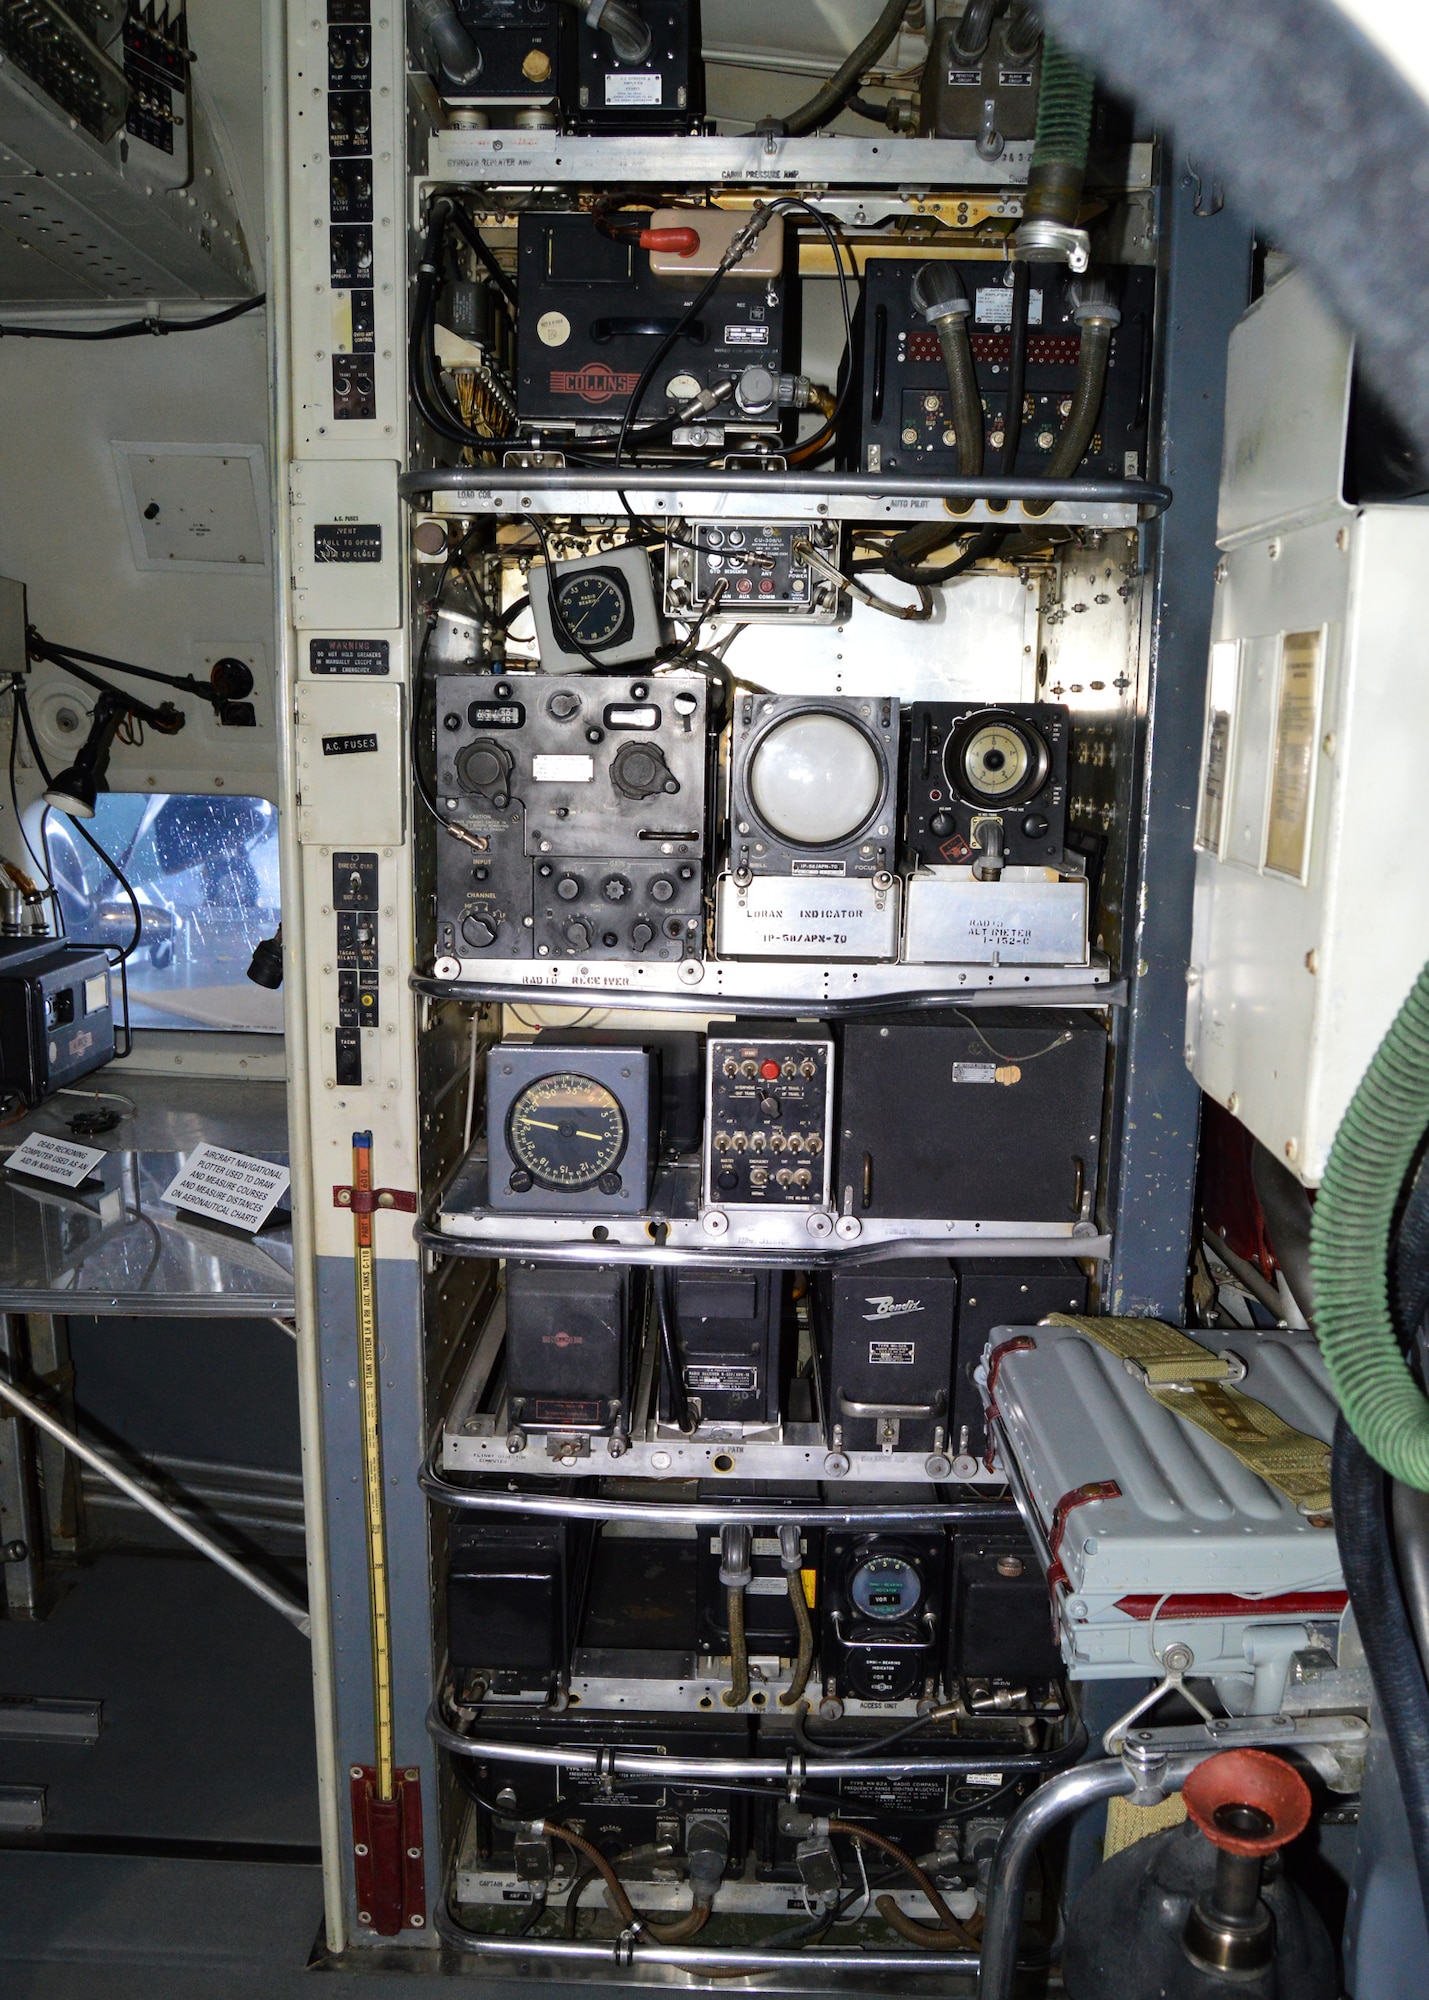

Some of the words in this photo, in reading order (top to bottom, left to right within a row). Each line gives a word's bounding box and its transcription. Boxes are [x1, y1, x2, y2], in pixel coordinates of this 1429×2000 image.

[481, 158, 515, 167] REPEATER
[746, 170, 781, 179] PRESSURE
[565, 375, 627, 391] COLLINS
[458, 490, 475, 499] LOAD
[890, 500, 909, 508] AUTO
[910, 500, 930, 509] PILOT
[338, 527, 357, 535] VENT
[328, 642, 370, 650] WARNING
[325, 741, 341, 751] A.C.
[344, 738, 376, 750] FUSES
[746, 910, 783, 918] LORAN
[800, 910, 863, 918] INDICATOR
[968, 919, 1004, 928] RADIO
[967, 928, 1032, 937] ALTIMETER
[522, 976, 558, 985] RADIO
[571, 976, 630, 986] RECEIVER
[544, 1090, 557, 1099] 30
[566, 1087, 578, 1095] 33
[529, 1100, 539, 1112] 27
[37, 1140, 55, 1150] DEAD
[54, 1145, 88, 1159] RECKONING
[525, 1141, 536, 1151] 21
[21, 1146, 54, 1161] COMPUTER
[52, 1155, 70, 1165] USED
[69, 1160, 78, 1168] AS
[539, 1157, 550, 1167] 18
[37, 1161, 74, 1177] NAVIGATION
[203, 1150, 236, 1164] AIRCRAFT
[234, 1160, 283, 1179] NAVIGATIONAL
[559, 1165, 569, 1174] 15
[579, 1162, 589, 1170] 12
[197, 1160, 225, 1174] PLOTTER
[224, 1168, 244, 1180] USED
[243, 1174, 253, 1183] TO
[253, 1177, 276, 1190] DRAW
[360, 1169, 368, 1188] 6010
[189, 1170, 205, 1181] AND
[205, 1175, 238, 1190] MEASURE
[236, 1185, 268, 1201] COURSES
[179, 1180, 195, 1190] AND
[195, 1184, 227, 1199] MEASURE
[226, 1195, 264, 1212] DISTANCES
[171, 1189, 182, 1198] ON
[182, 1194, 230, 1215] AERONAUTICAL
[230, 1209, 258, 1224] CHARTS
[361, 1222, 369, 1238] PART
[362, 1250, 370, 1269] C-118
[362, 1271, 370, 1291] TANKS
[865, 1296, 921, 1314] Bendix
[363, 1309, 371, 1318] RH
[364, 1327, 371, 1335] LH
[364, 1337, 372, 1361] SYSTEM
[365, 1364, 373, 1378] TANK
[365, 1381, 373, 1389] 10
[599, 1824, 622, 1833] RELEASE
